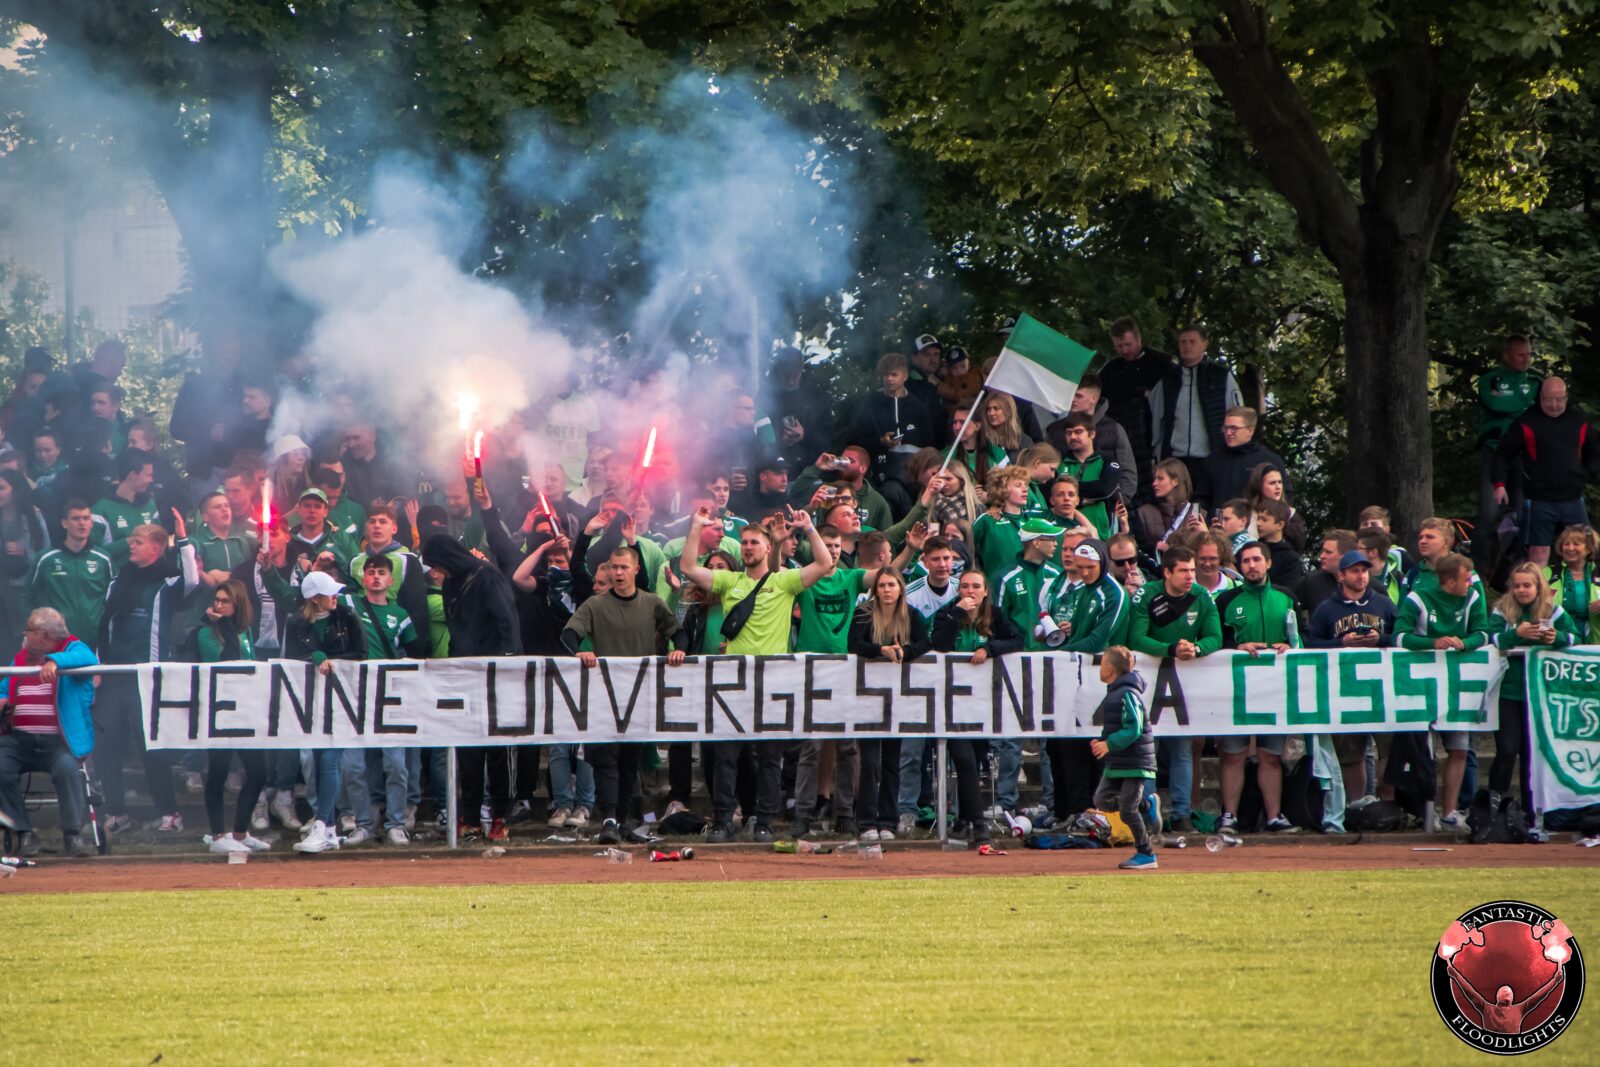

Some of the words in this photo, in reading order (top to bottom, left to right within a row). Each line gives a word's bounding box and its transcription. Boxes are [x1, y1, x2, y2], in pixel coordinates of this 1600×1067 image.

[150, 664, 419, 740] HENNE
[487, 655, 1055, 736] UNVERGESSEN!
[1232, 651, 1490, 725] COSSE
